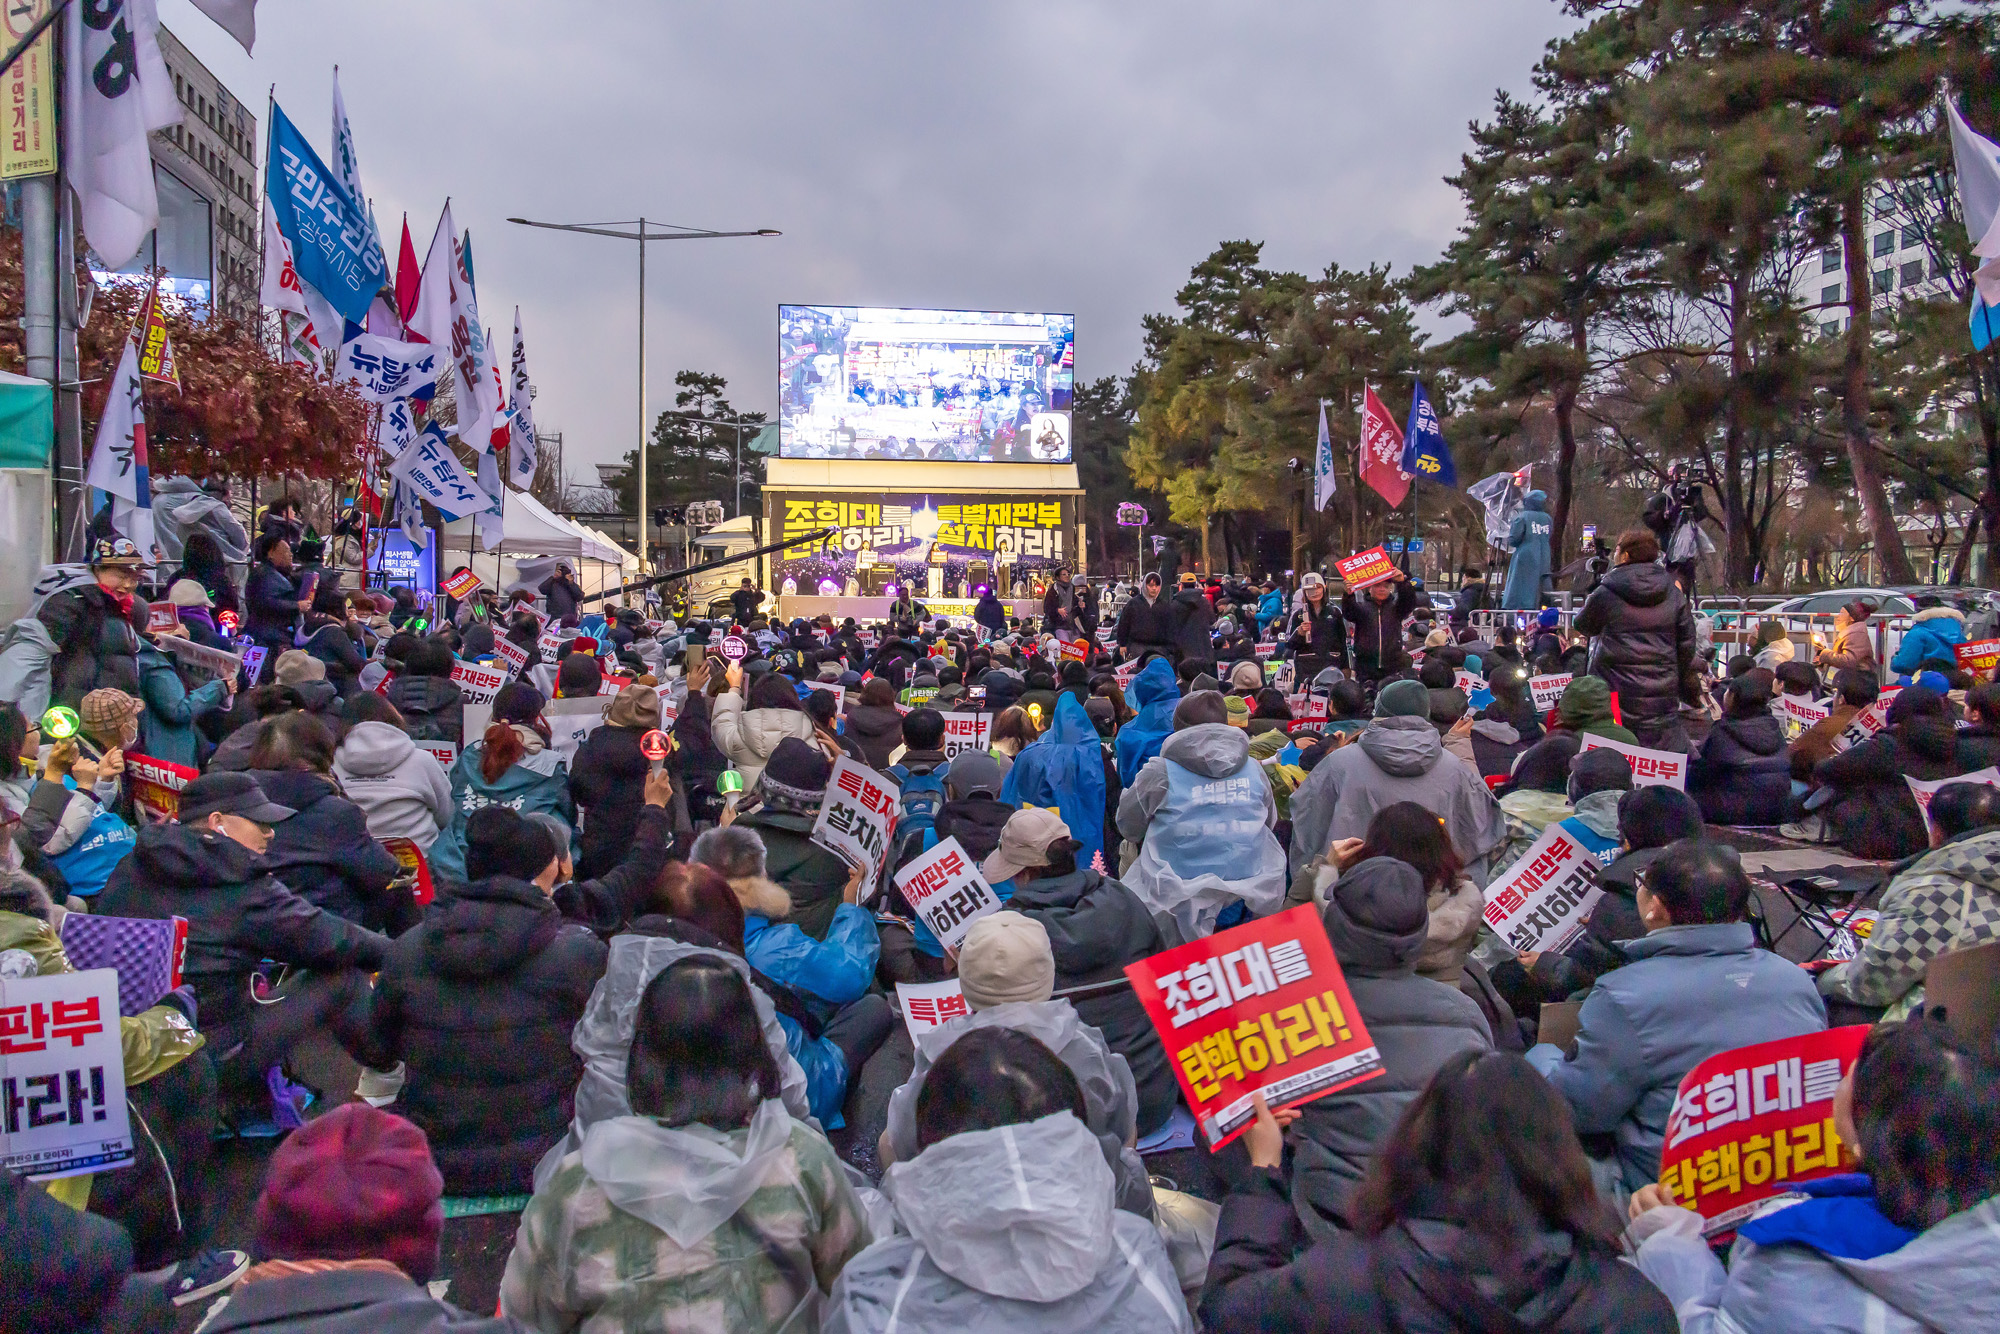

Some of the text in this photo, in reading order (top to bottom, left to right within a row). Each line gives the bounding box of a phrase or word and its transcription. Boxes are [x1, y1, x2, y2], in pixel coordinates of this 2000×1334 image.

[408, 466, 444, 498] 시민언론
[417, 438, 477, 501] 뉴탐사
[784, 499, 912, 530] 조희대를
[937, 502, 1062, 529] 특별재판부
[937, 523, 1063, 561] 설치하라!
[1343, 552, 1383, 573] 조희대를
[1346, 561, 1391, 583] 탄핵하라!
[944, 719, 988, 736] 재판부
[1484, 836, 1575, 926] 특별재판부
[1155, 938, 1313, 1030] 조희대를
[1176, 990, 1353, 1103] 탄핵하라!
[1669, 1056, 1844, 1150] 조희대를
